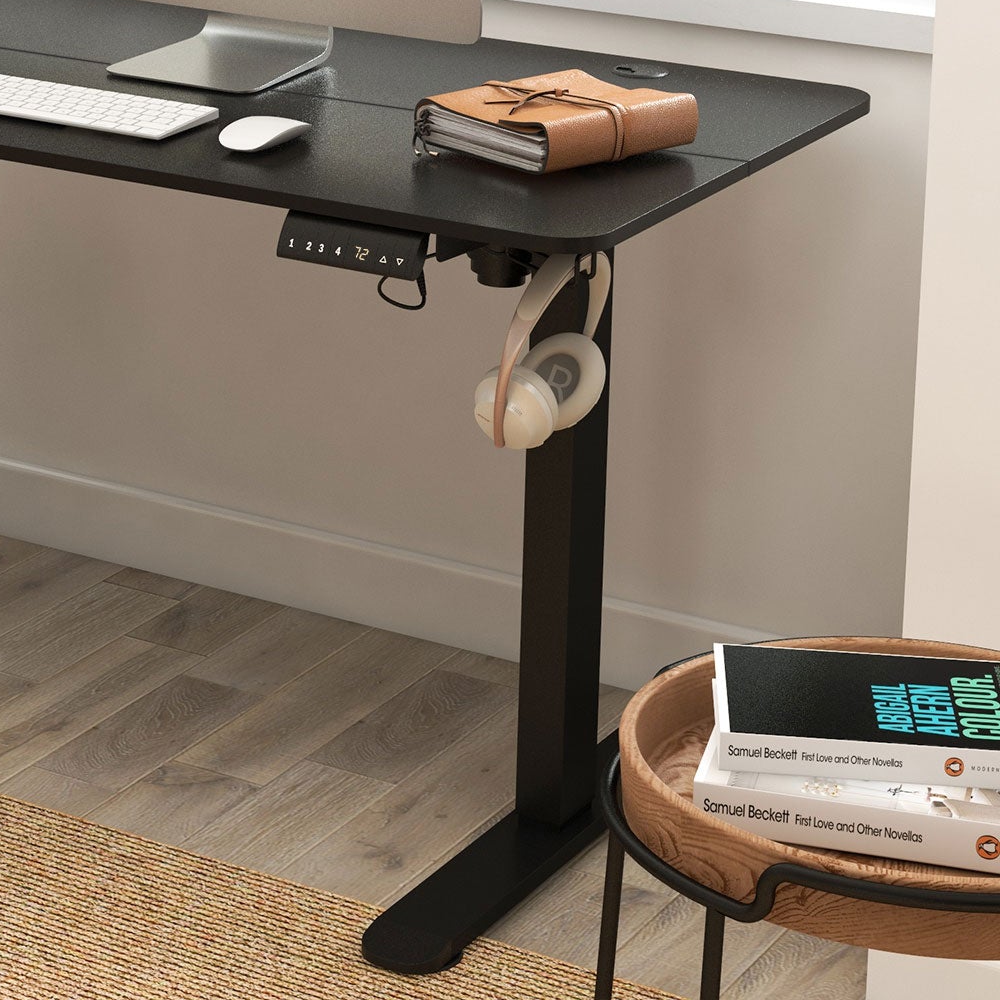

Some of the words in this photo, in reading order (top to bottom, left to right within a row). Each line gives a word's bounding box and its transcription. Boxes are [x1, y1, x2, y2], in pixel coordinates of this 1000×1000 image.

[288, 238, 295, 248] 1
[305, 241, 313, 251] 2
[318, 243, 325, 253] 3
[334, 246, 341, 256] 4
[355, 245, 370, 261] 72
[547, 363, 573, 403] R
[870, 683, 916, 734] ABIGAIL
[907, 683, 961, 738] AHERN
[727, 744, 762, 758] Samuel
[763, 747, 798, 761] Beckett
[801, 751, 816, 762] First
[816, 752, 833, 763] Love
[834, 754, 850, 764] and
[850, 755, 871, 766] Other
[872, 757, 903, 768] Novellas
[703, 798, 746, 818] Samuel
[748, 804, 790, 824] Beckett
[795, 814, 812, 827] First
[813, 816, 835, 830] Love
[836, 820, 855, 833] and
[856, 823, 883, 837] Other
[884, 827, 923, 843] Novellas
